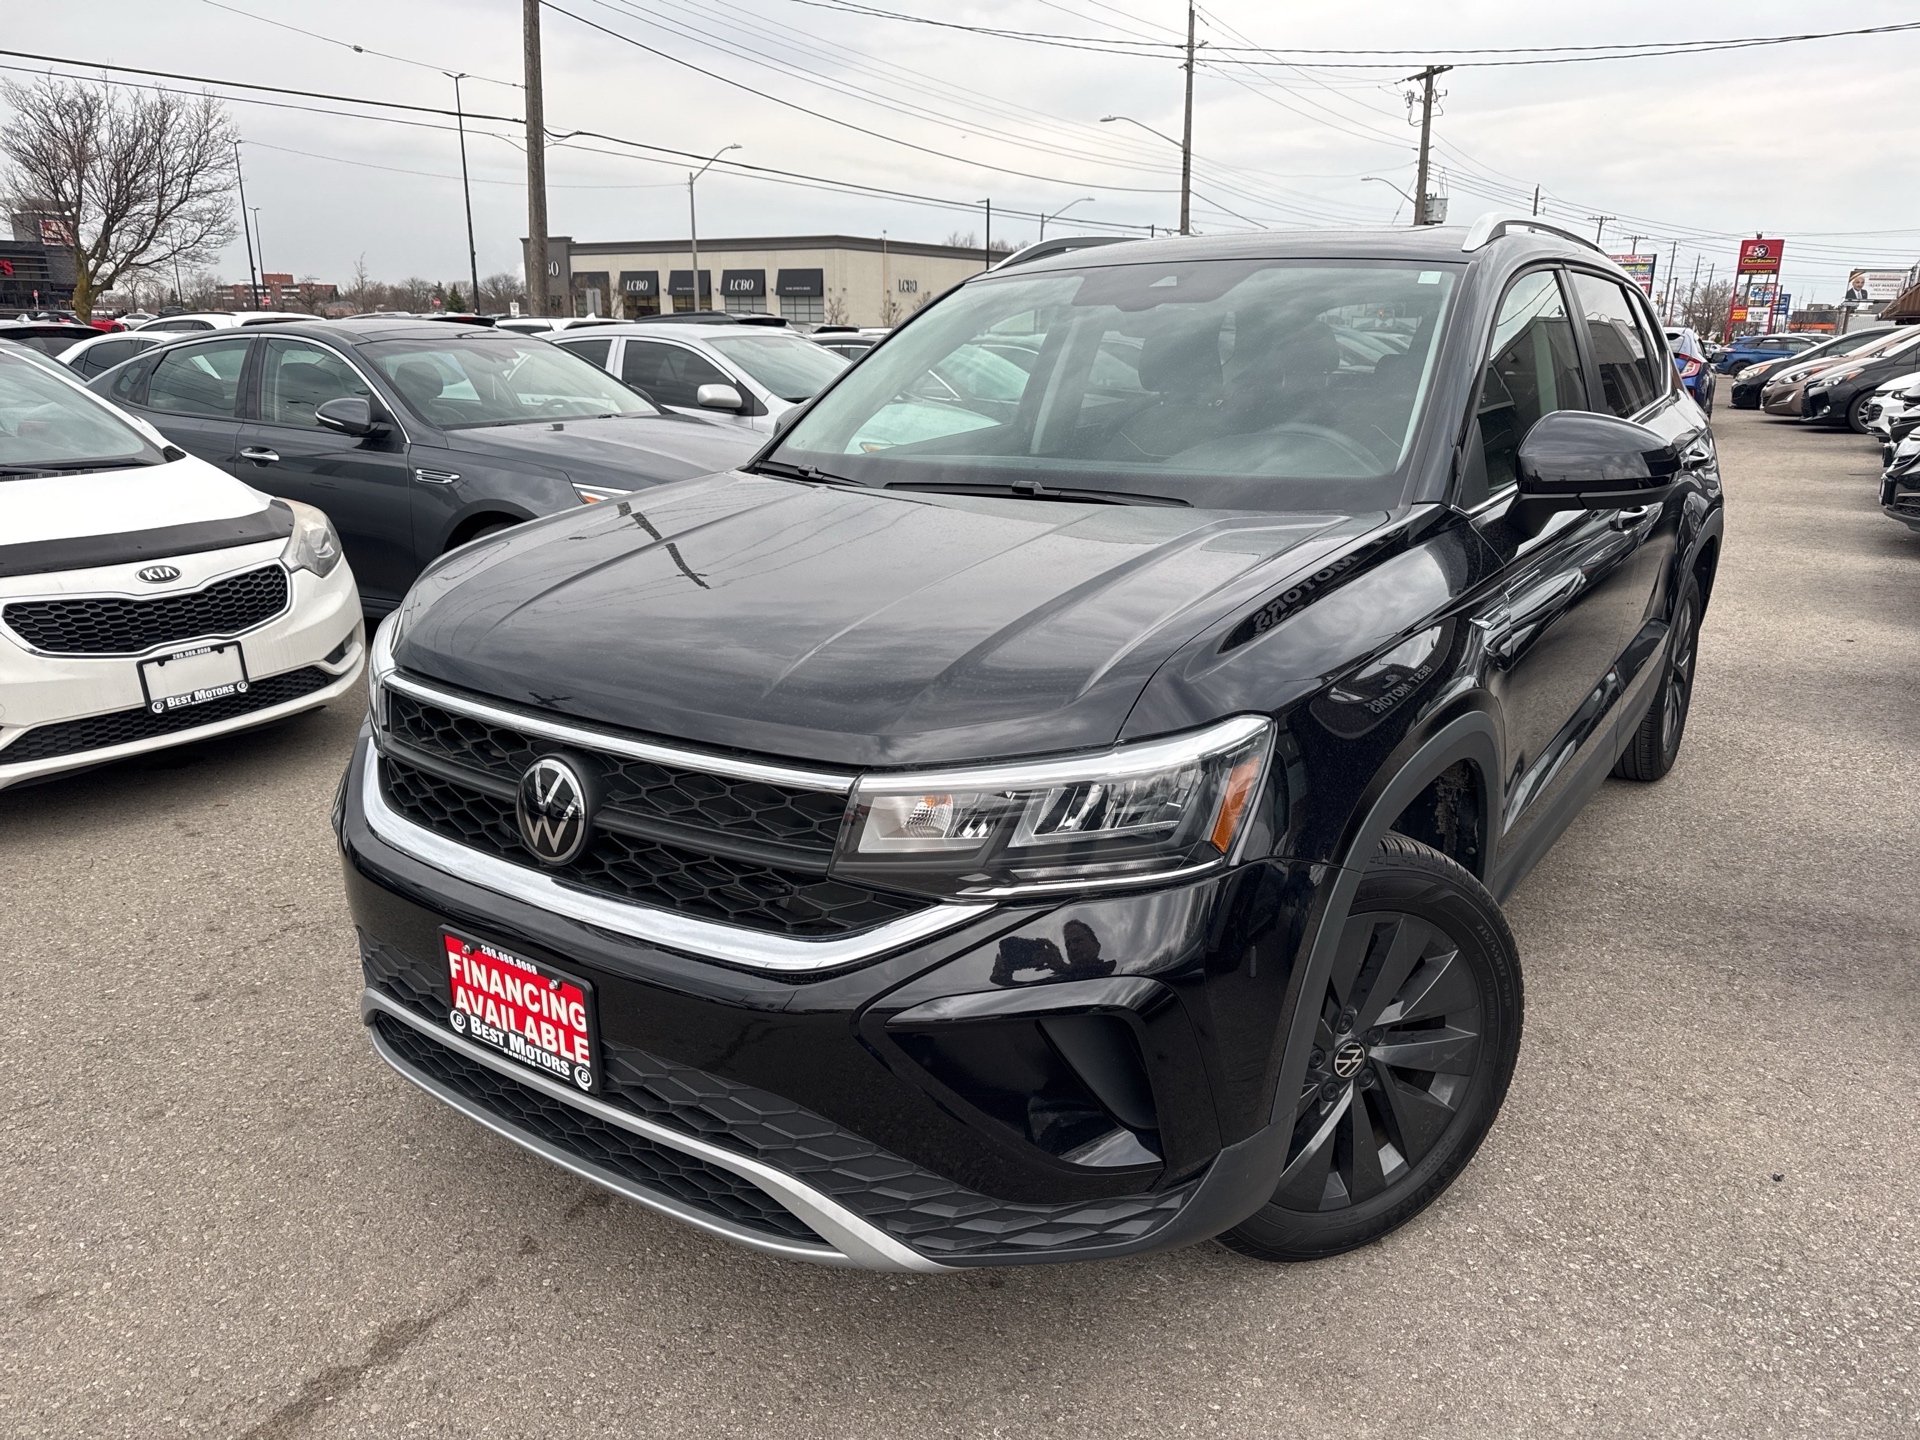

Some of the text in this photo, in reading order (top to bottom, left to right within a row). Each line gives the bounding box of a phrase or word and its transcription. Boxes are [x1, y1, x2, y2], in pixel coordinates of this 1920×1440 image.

[626, 280, 649, 292] LCBO
[729, 279, 754, 291] LCBO
[898, 279, 918, 293] LCBO
[143, 567, 178, 580] KIA
[166, 685, 236, 708] BEST MOTORS
[448, 951, 588, 1033] FINANCING
[455, 986, 591, 1068] AVAILABLE
[470, 1015, 571, 1076] BEST MOTORS
